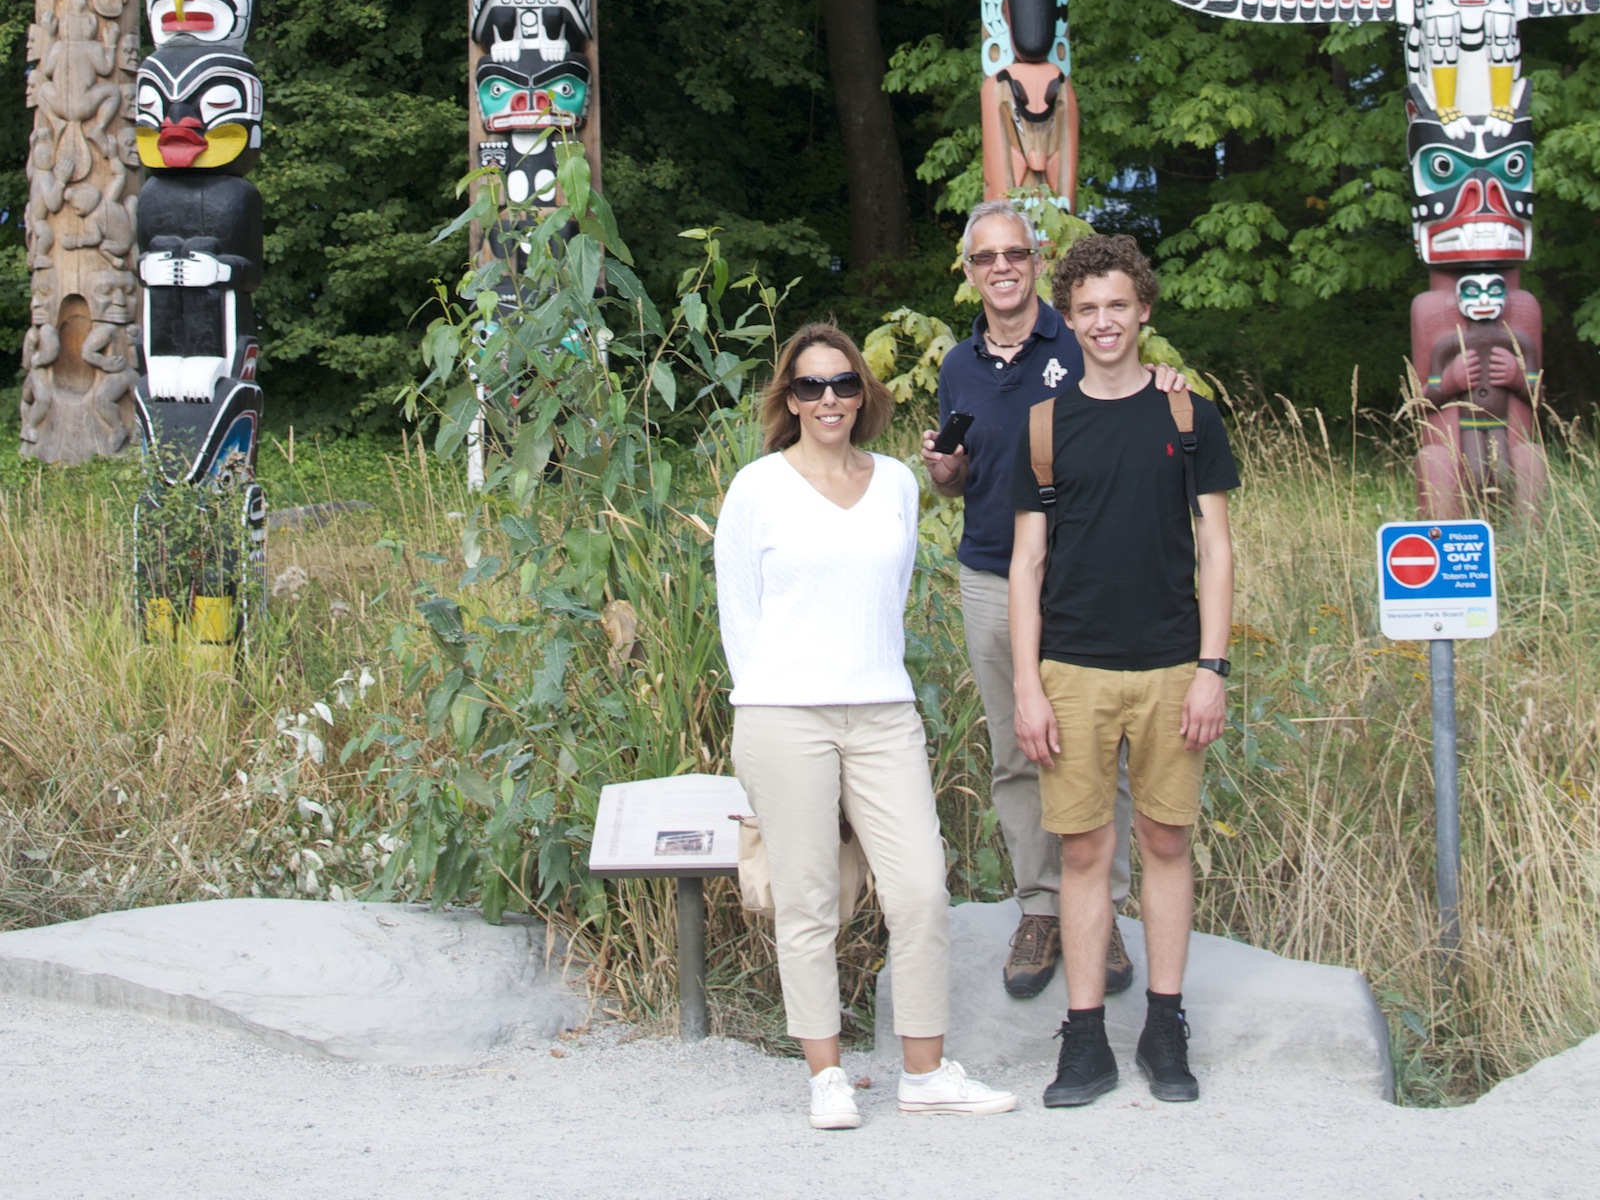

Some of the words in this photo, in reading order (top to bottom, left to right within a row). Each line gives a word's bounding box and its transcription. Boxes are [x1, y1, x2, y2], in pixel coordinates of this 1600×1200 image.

[1449, 533, 1479, 541] Please
[1442, 542, 1485, 552] STAY
[1447, 552, 1482, 562] OUT
[1441, 572, 1468, 580] Totem
